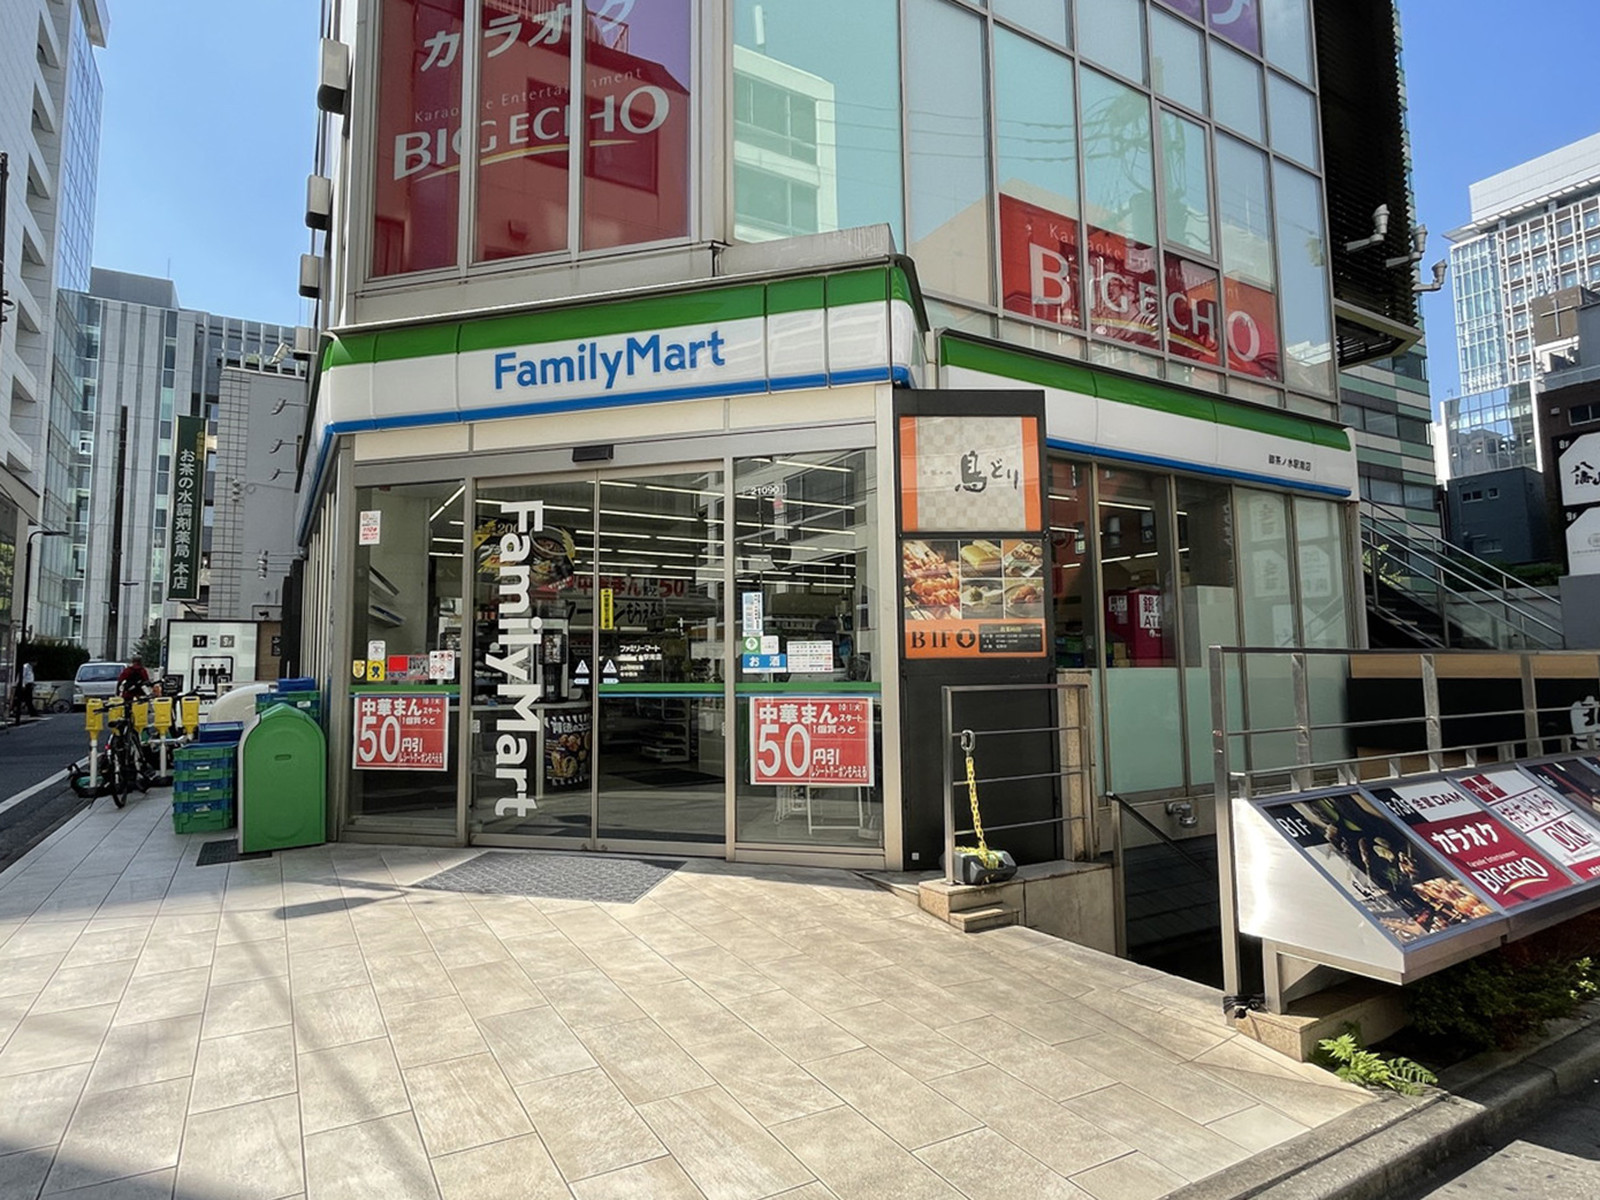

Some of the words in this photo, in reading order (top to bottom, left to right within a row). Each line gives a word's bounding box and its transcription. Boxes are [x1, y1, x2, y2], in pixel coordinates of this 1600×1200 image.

[414, 99, 493, 123] Karaoe
[495, 330, 725, 389] FamilyMart
[175, 449, 195, 558] お茶の水調剤薬局
[172, 562, 189, 590] 本店
[486, 500, 543, 817] FamilyMart
[362, 698, 422, 716] 中華まん
[759, 704, 838, 724] 中華まん
[359, 716, 400, 762] 50
[757, 724, 810, 777] 50
[1276, 817, 1311, 838] B1F
[1431, 822, 1499, 855] カラオケ
